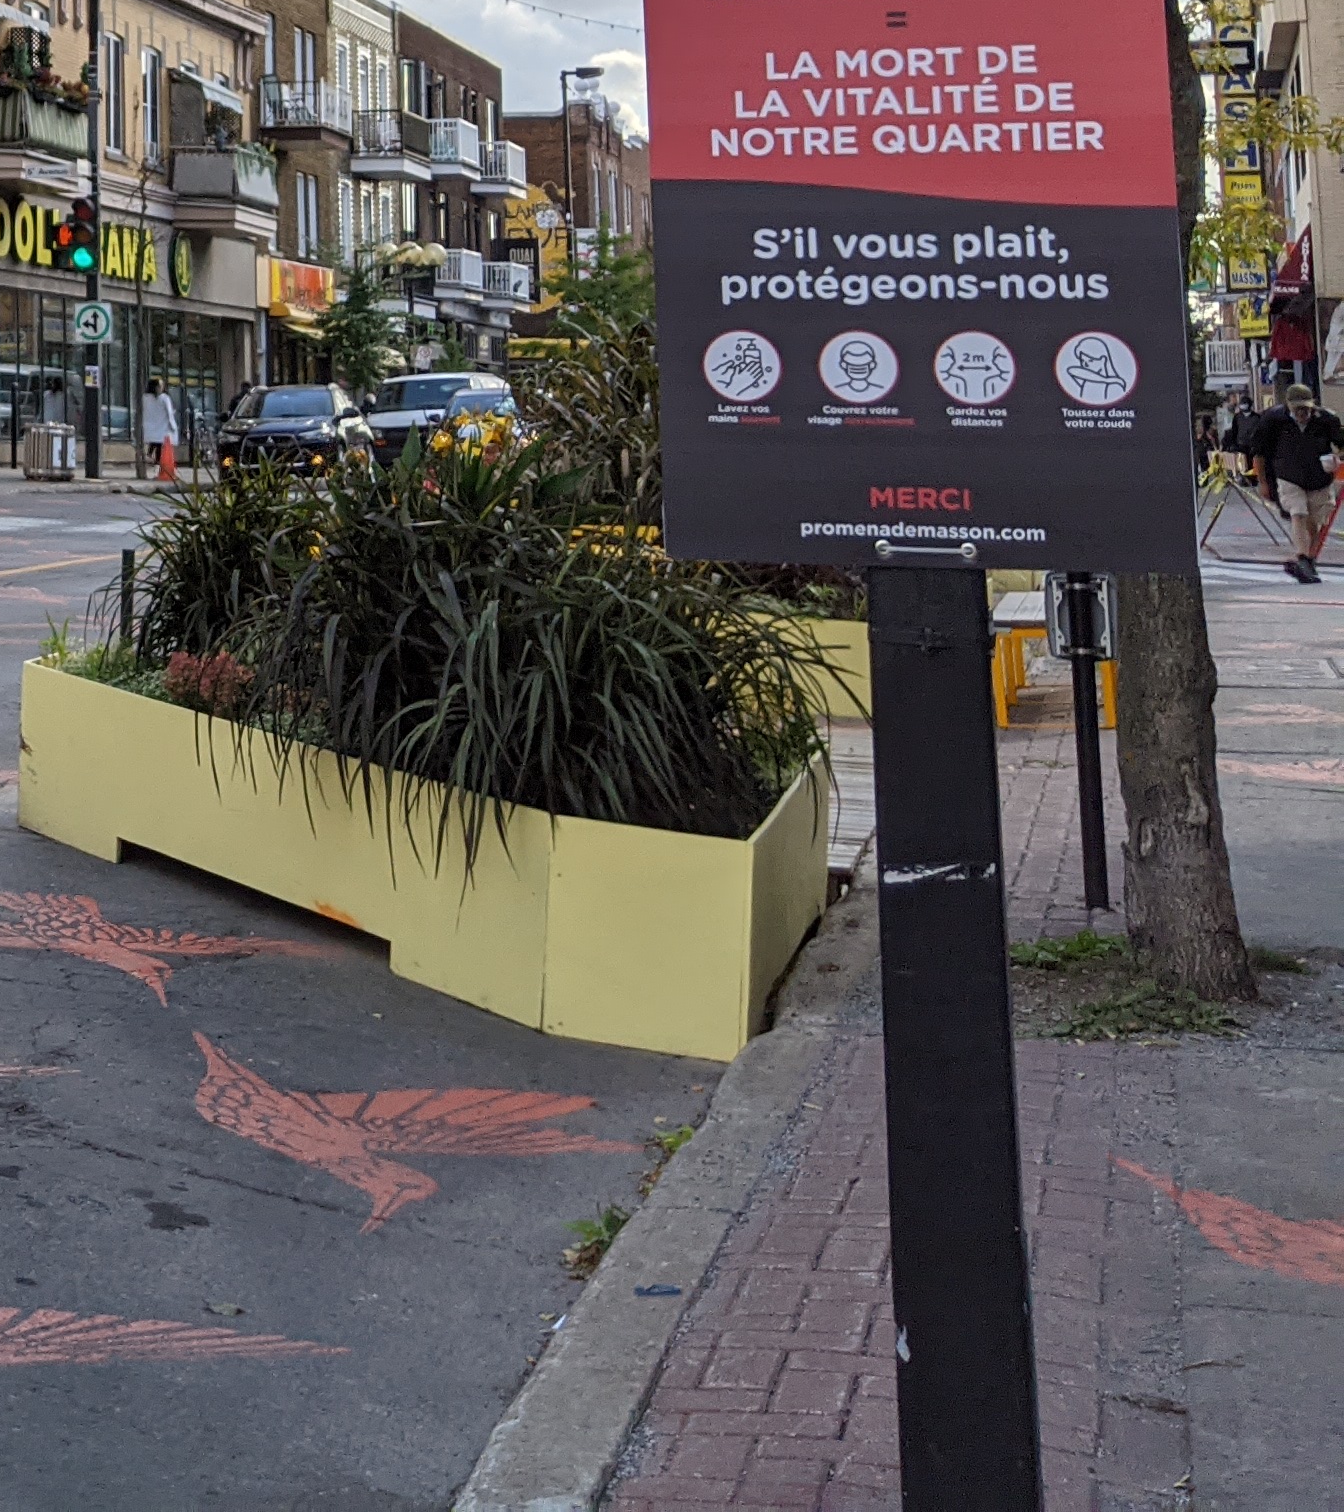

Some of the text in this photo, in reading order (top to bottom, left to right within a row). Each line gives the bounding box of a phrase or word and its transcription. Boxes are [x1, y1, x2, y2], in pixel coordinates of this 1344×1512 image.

[764, 43, 1039, 81] LA MORT DE
[734, 76, 1075, 120] LA VITALITÉ DE
[710, 121, 1105, 157] NOTRE QUARTIER
[832, 230, 939, 261] vous
[953, 225, 1070, 265] plait,
[720, 265, 1109, 307] protégeons-nous
[717, 403, 770, 414] Lavez vos
[822, 404, 900, 416] Couvrez votre
[946, 406, 1008, 417] Gardez vos
[1061, 407, 1135, 419] Toussez dans
[707, 414, 739, 424] mains
[807, 415, 843, 426] visage
[951, 417, 1003, 428] distances
[1065, 419, 1133, 429] votre coude
[869, 486, 972, 511] MERCI
[800, 519, 1047, 543] promenademasson.com
